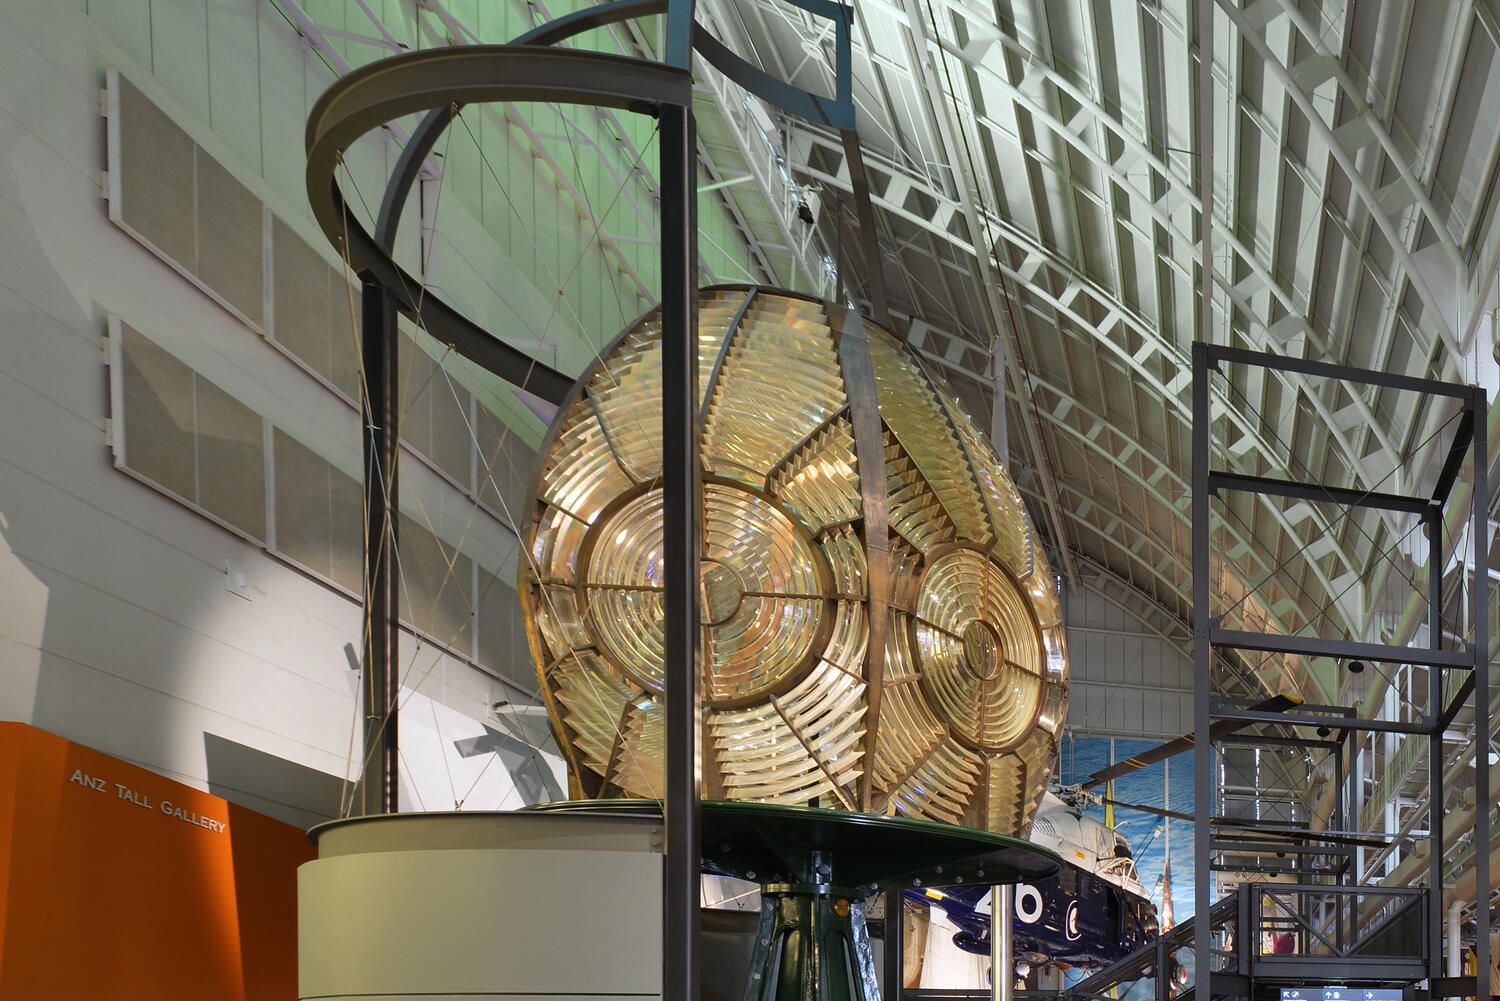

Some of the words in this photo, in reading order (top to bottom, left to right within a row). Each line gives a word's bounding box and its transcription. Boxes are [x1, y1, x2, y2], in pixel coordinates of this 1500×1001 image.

[69, 769, 107, 793] ANZ
[115, 783, 153, 809] TALL
[160, 800, 227, 833] GALLERY
